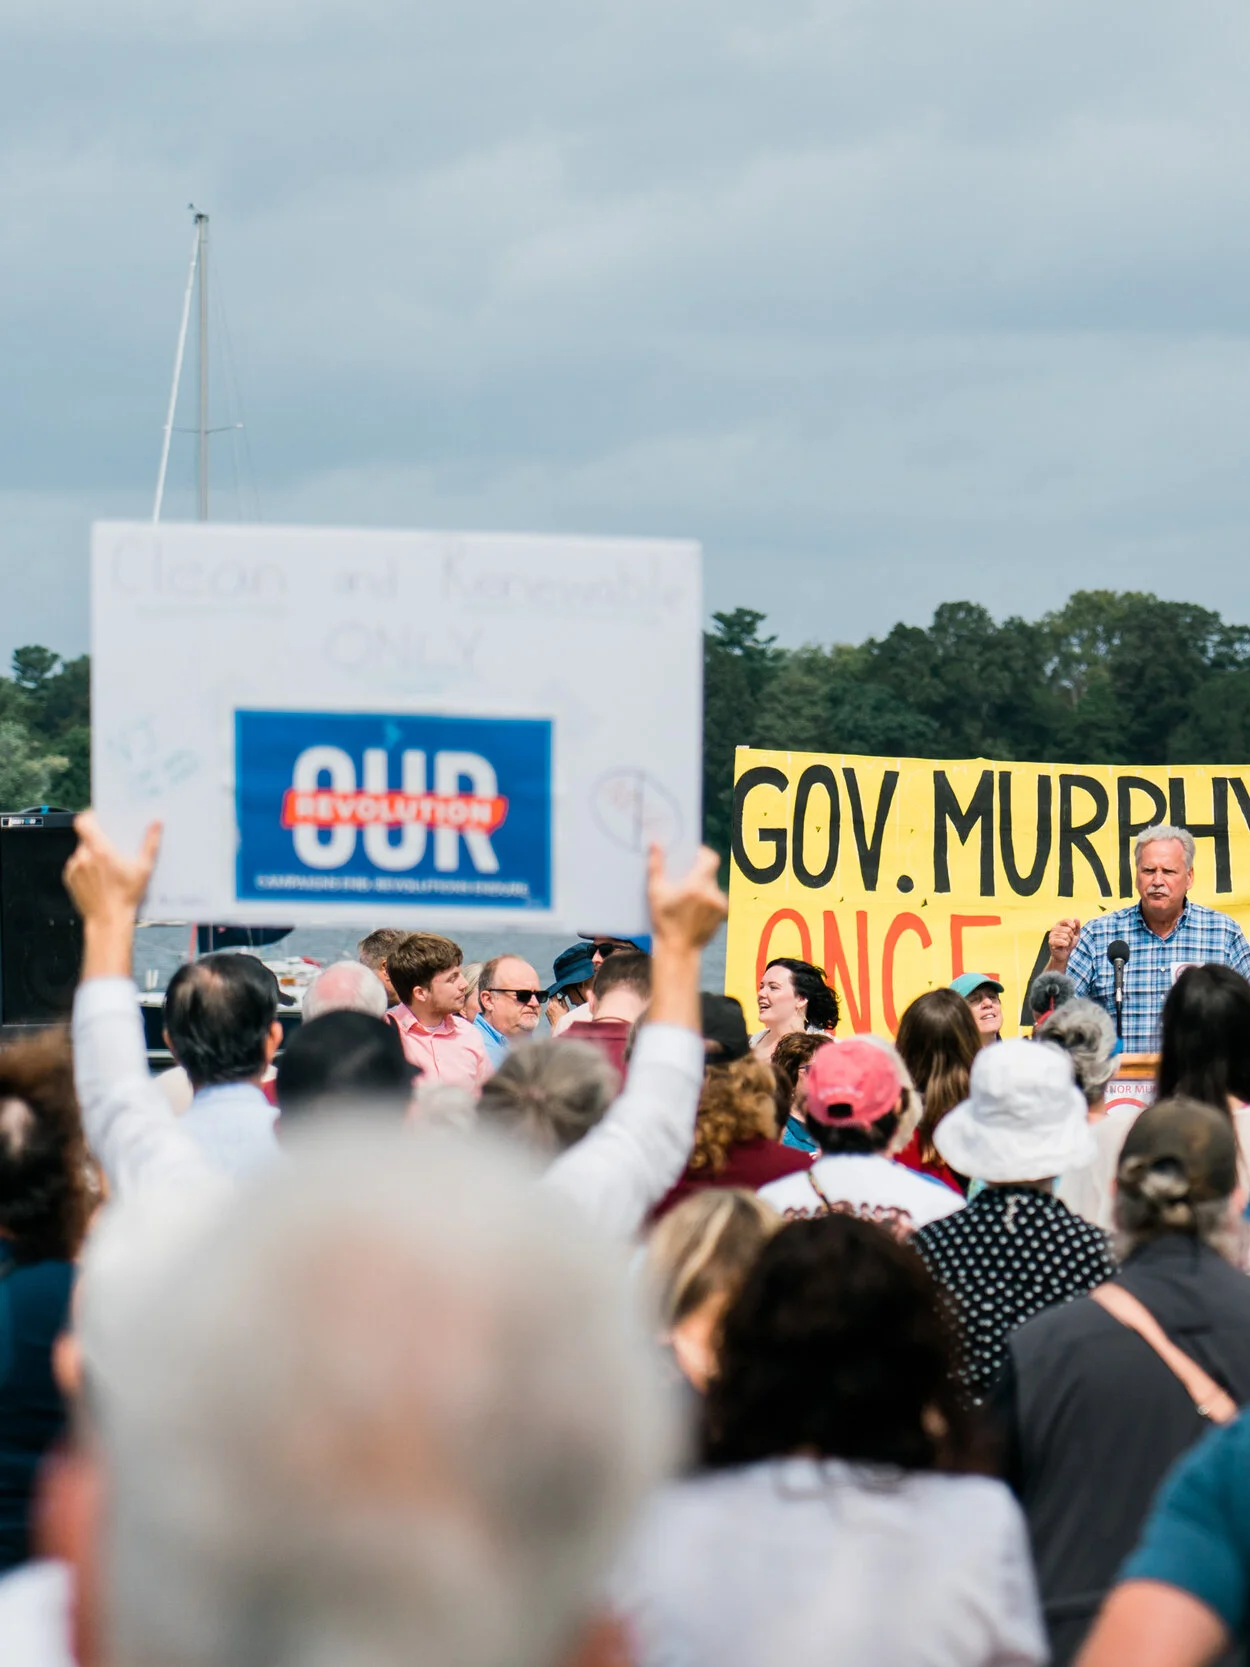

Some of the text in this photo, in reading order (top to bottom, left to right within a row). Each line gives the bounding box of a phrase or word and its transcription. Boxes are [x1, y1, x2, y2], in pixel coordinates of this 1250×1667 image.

[292, 745, 500, 873] OUR
[295, 795, 491, 823] REVOLUTION
[731, 763, 915, 894] GOV.
